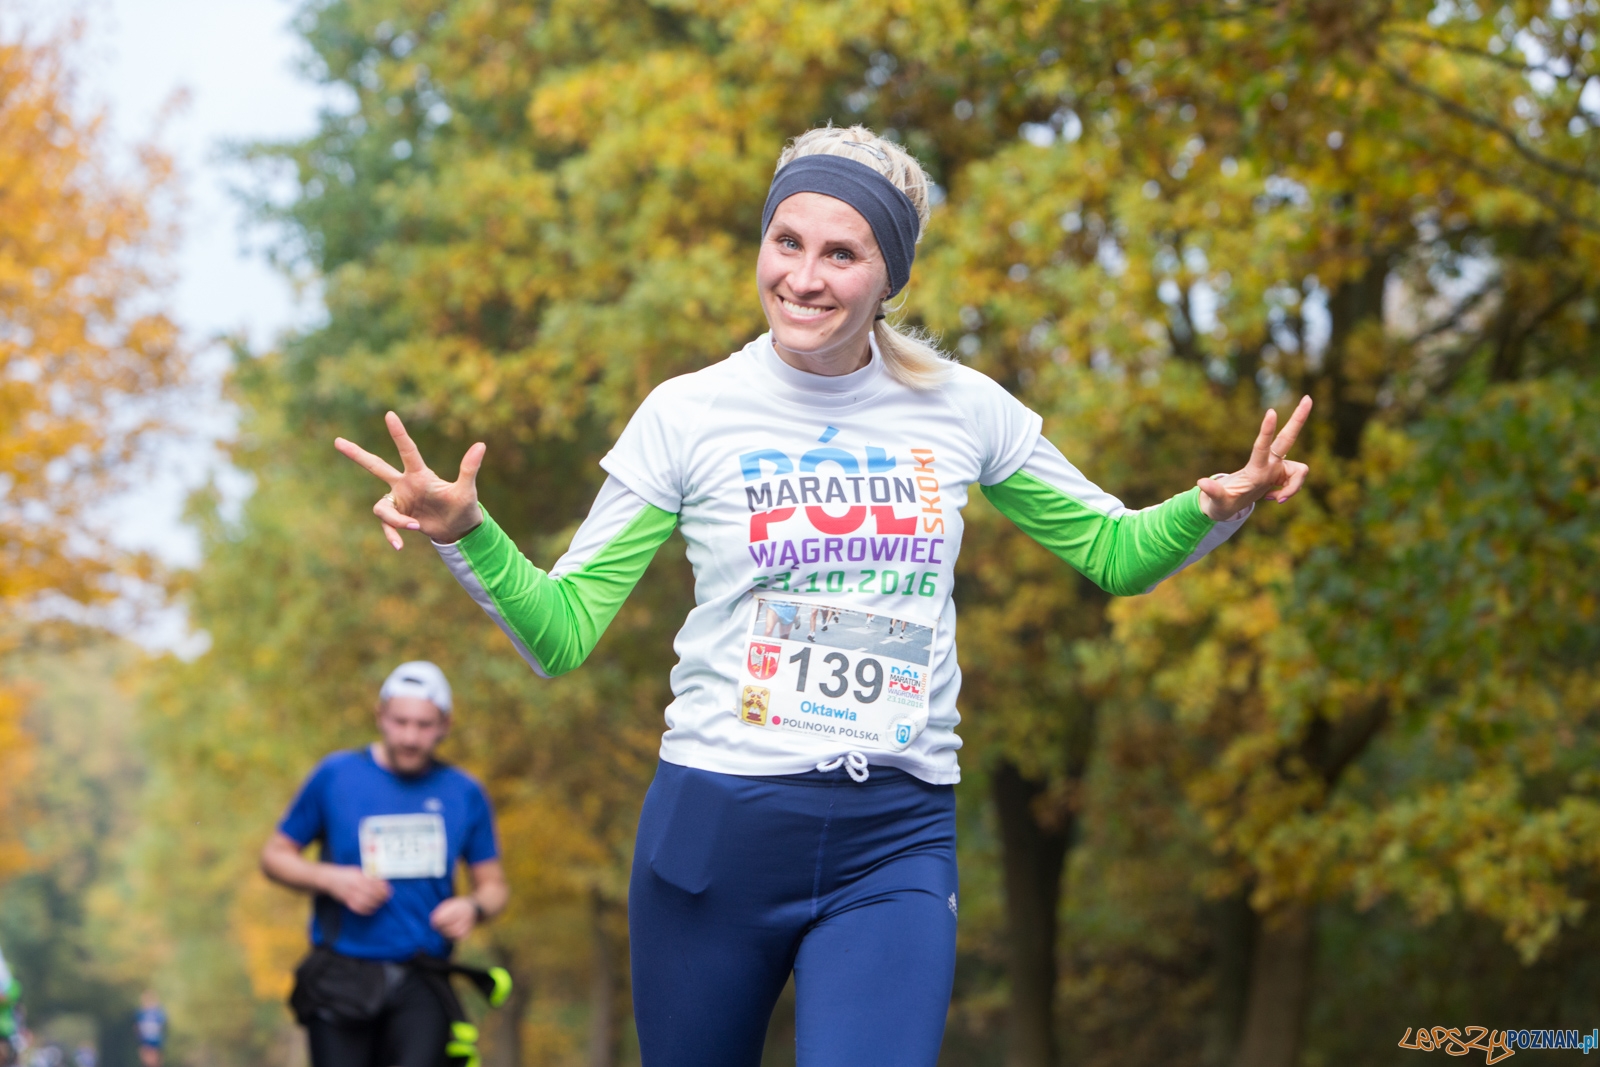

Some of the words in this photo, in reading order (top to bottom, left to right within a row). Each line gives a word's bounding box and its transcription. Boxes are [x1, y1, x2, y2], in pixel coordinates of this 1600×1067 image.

[745, 476, 917, 512] MARATON
[910, 448, 945, 535] SKOKI
[748, 537, 945, 570] WĄGROWIEC
[789, 646, 884, 704] 139
[889, 674, 921, 687] MARATON
[800, 701, 857, 721] Oktawia
[886, 695, 924, 709] 23.10.2016
[782, 717, 836, 735] POLINOVA
[838, 727, 879, 742] POLSKA
